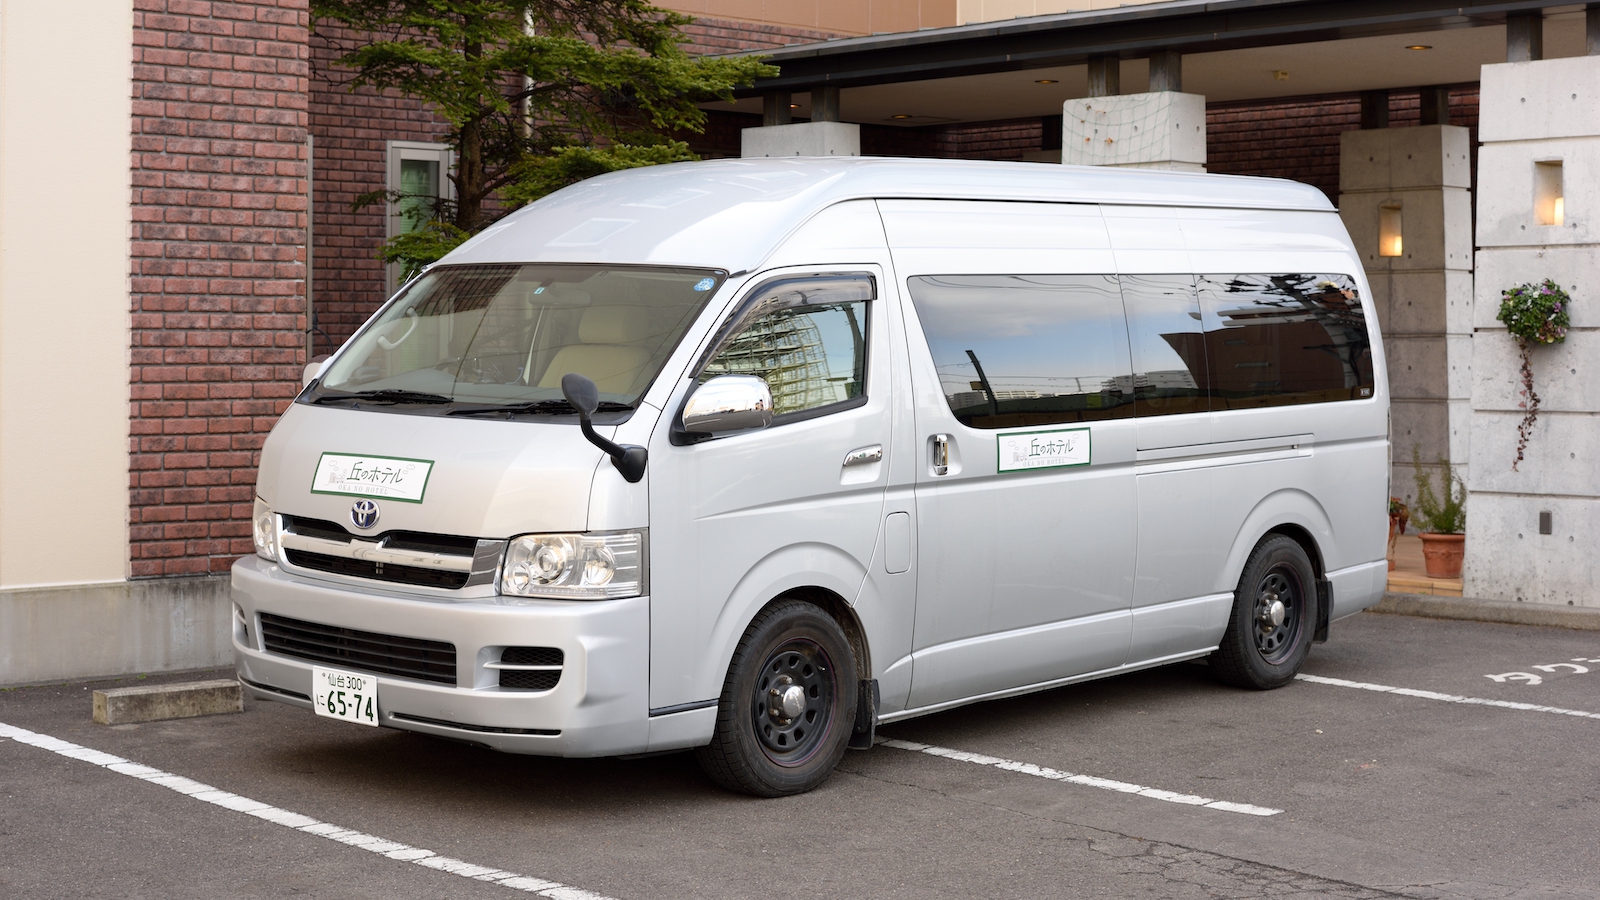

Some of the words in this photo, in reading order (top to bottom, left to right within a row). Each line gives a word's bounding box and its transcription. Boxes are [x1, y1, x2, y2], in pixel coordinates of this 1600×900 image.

[1028, 437, 1074, 457] 丘のホテル
[346, 461, 404, 484] 丘のホテル
[365, 486, 389, 495] HOTEL
[316, 693, 325, 706] に
[327, 690, 374, 722] 65-74
